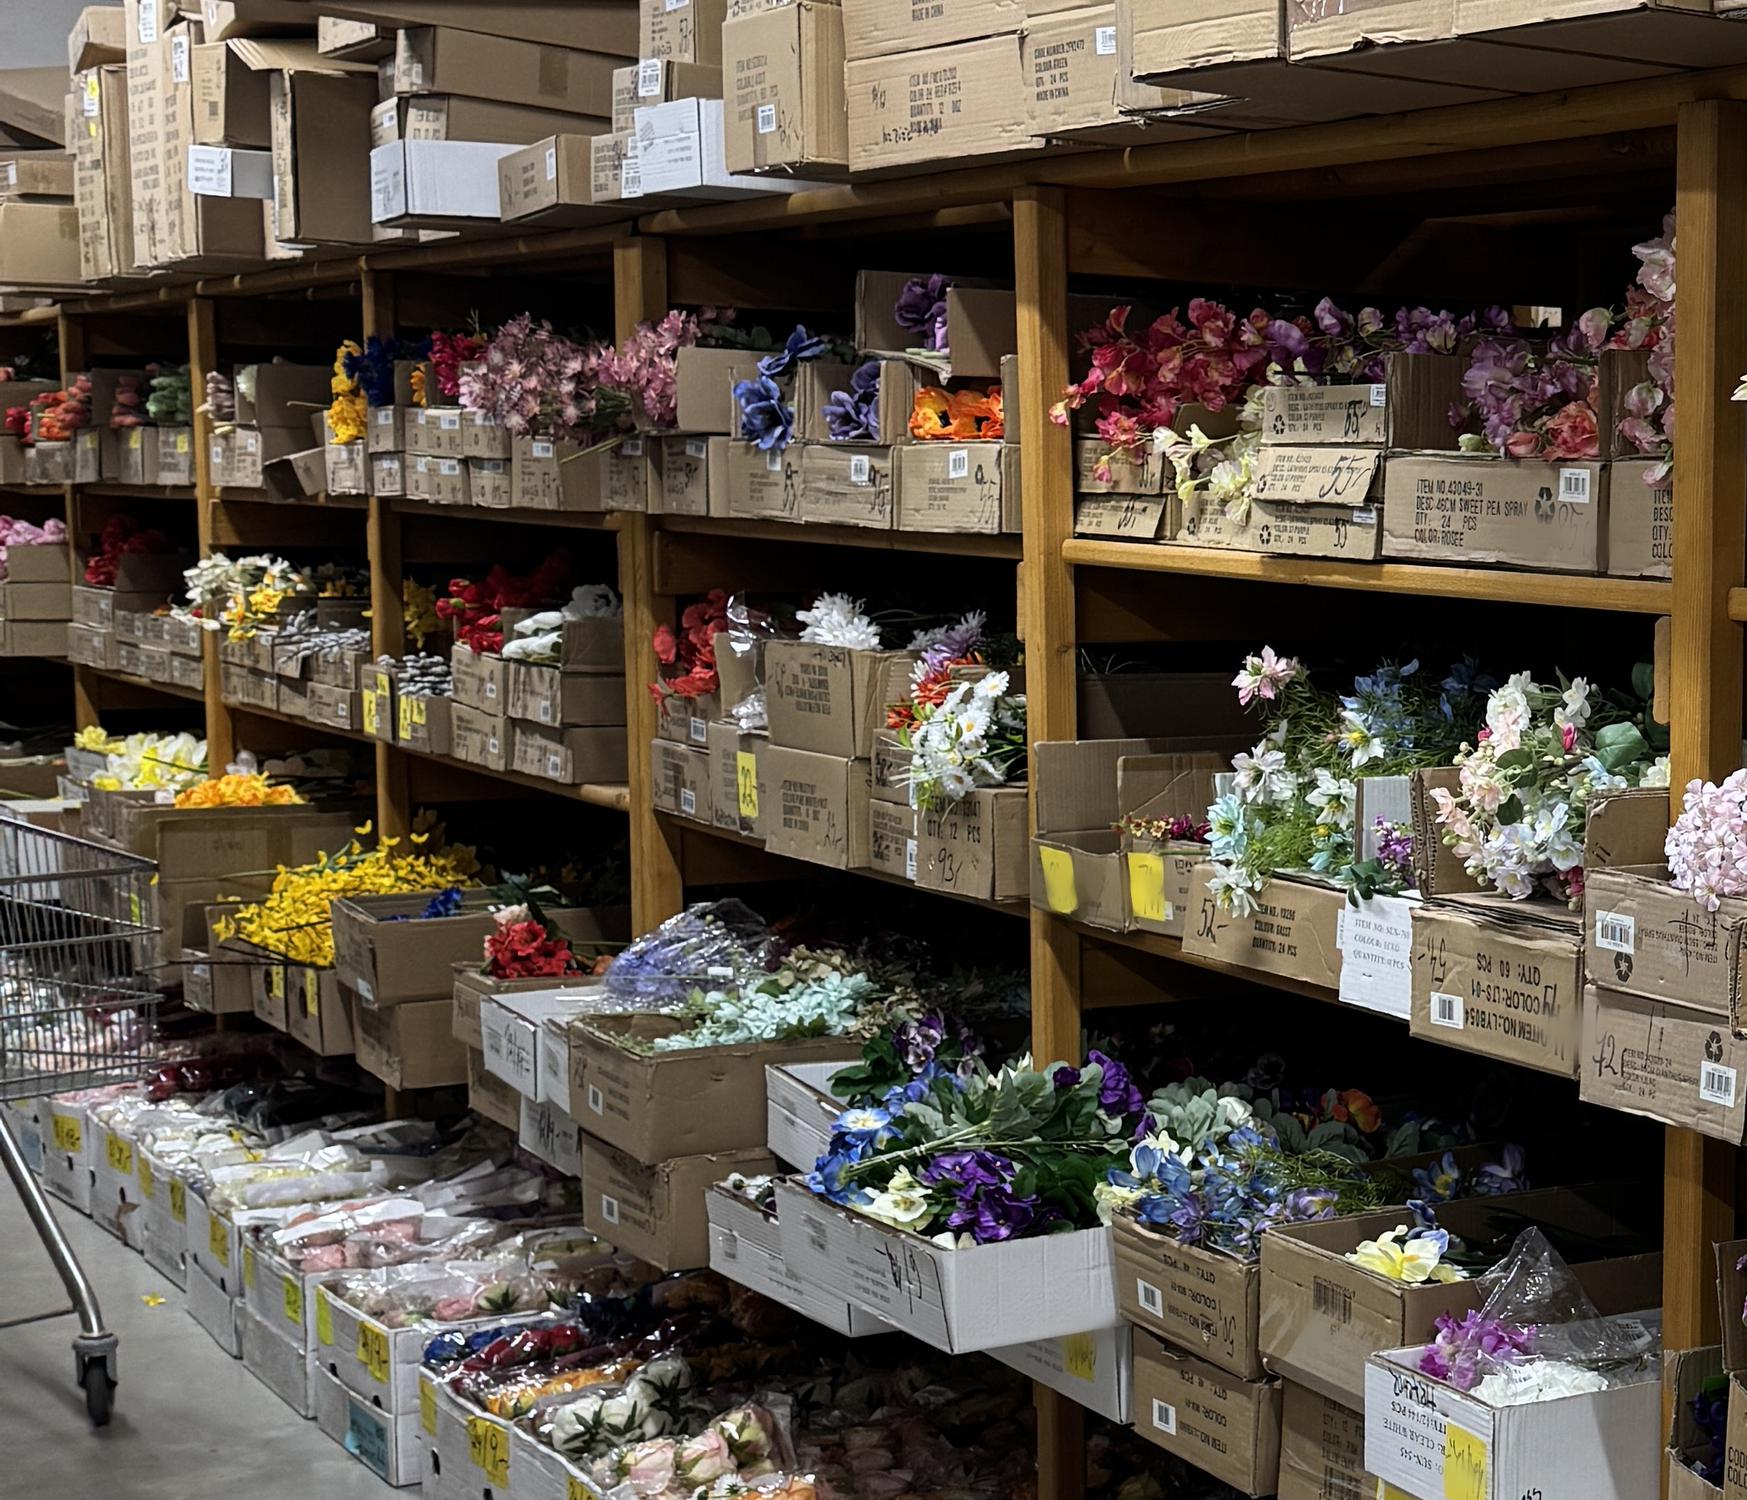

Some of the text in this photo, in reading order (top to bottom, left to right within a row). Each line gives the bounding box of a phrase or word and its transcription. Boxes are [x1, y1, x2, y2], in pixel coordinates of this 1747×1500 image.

[1416, 479, 1434, 492] ITEM
[1458, 498, 1528, 518] SWEET PEA SPRAY
[1440, 516, 1477, 531] 24 PCS
[1476, 952, 1541, 987] PCS 60 QTY:
[1517, 1019, 1540, 1044] ITEM
[1408, 1428, 1435, 1451] CLEAR
